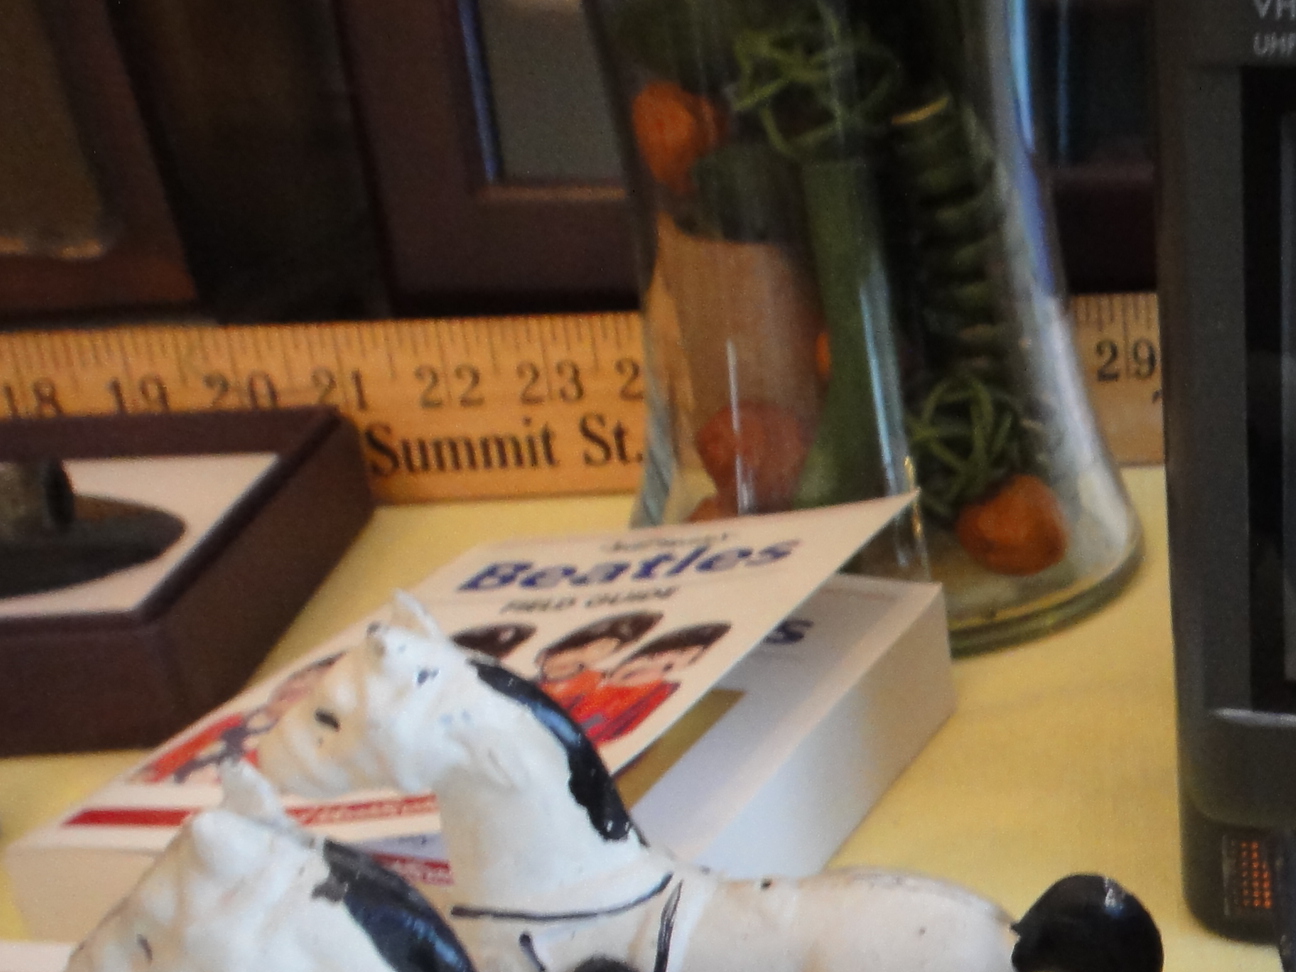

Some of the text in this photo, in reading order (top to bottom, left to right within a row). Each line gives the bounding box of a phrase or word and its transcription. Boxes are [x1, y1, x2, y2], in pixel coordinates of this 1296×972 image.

[414, 364, 485, 409] 22
[516, 359, 586, 405] 23
[1096, 338, 1157, 382] 29
[363, 412, 643, 477] Summit St.
[457, 538, 802, 592] Beatles
